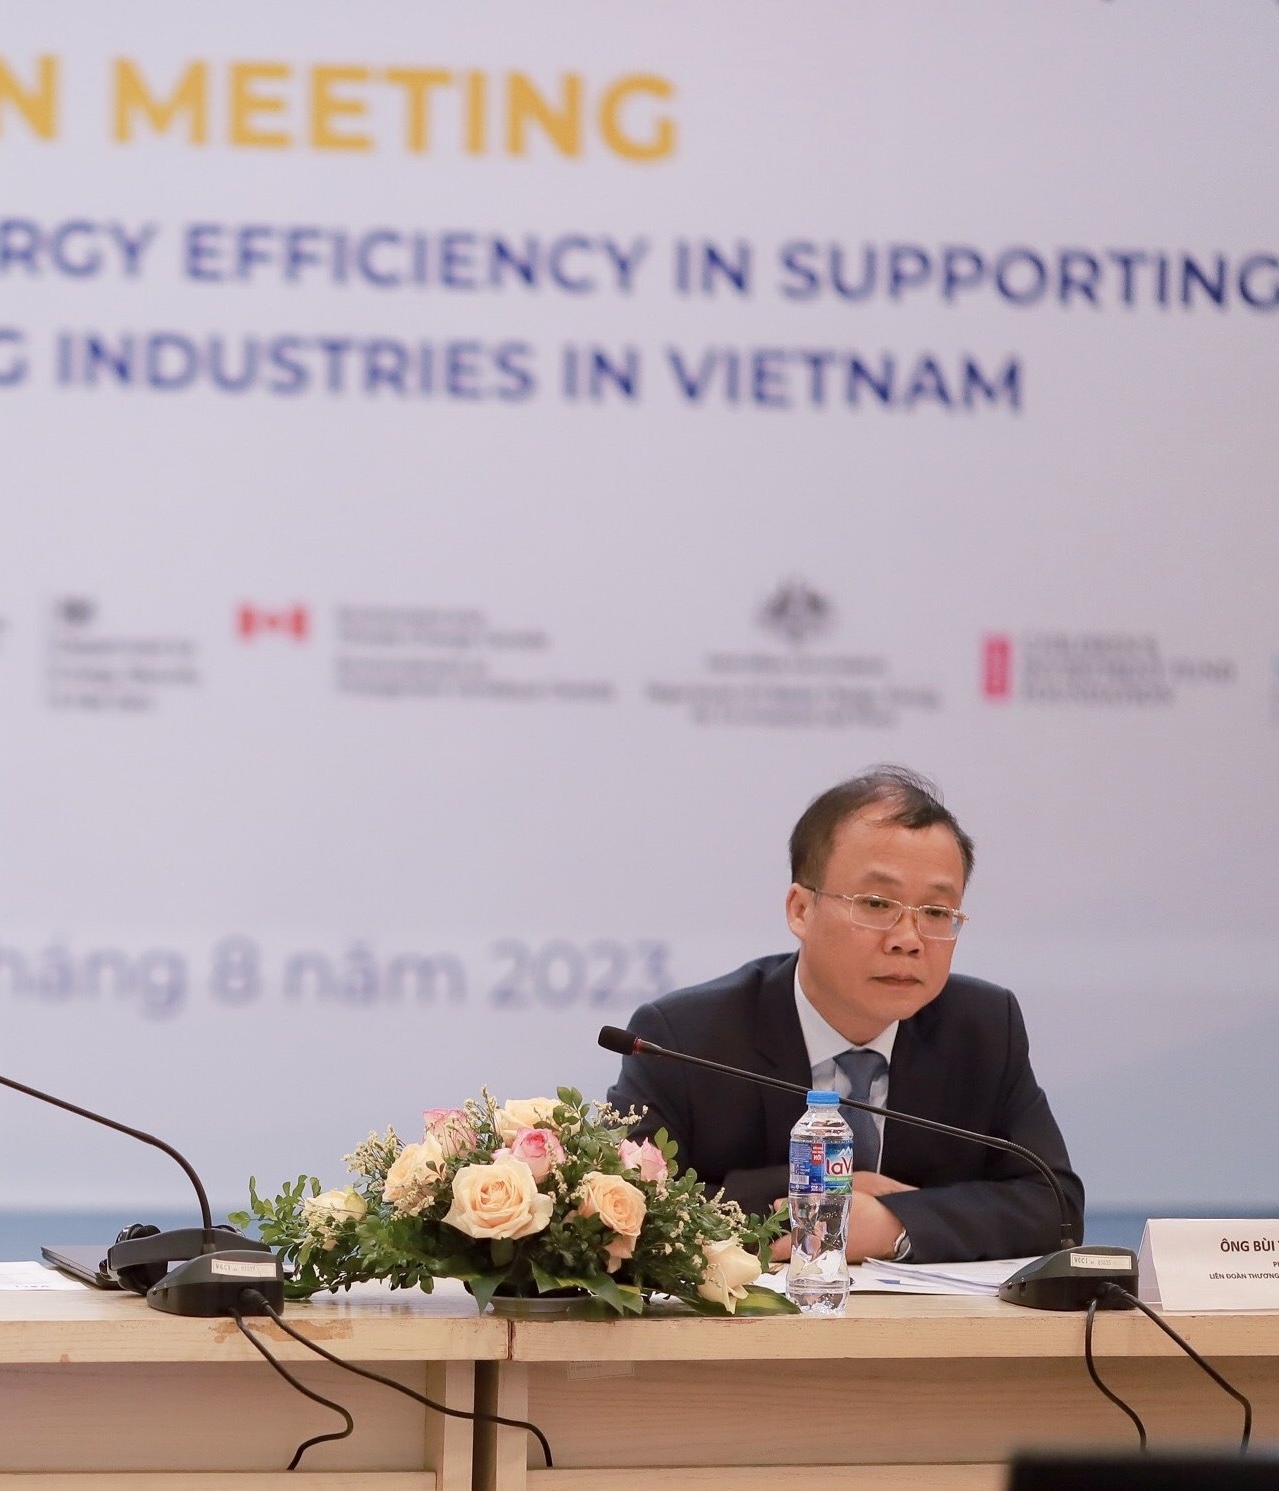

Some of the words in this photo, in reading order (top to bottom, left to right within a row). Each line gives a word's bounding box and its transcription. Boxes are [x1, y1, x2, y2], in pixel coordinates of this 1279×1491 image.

[112, 58, 678, 164] MEETING
[182, 223, 650, 296] EFFICIENCY
[675, 241, 751, 296] IN
[781, 242, 1279, 314] SUPPORTING
[57, 331, 538, 404] INDUSTRIES
[563, 347, 640, 402] IN
[668, 350, 1024, 413] VIETNAM
[208, 934, 263, 1006] 8
[488, 938, 678, 1010] 2023
[1220, 1237, 1250, 1252] ÔNG
[1253, 1237, 1275, 1252] BÙI
